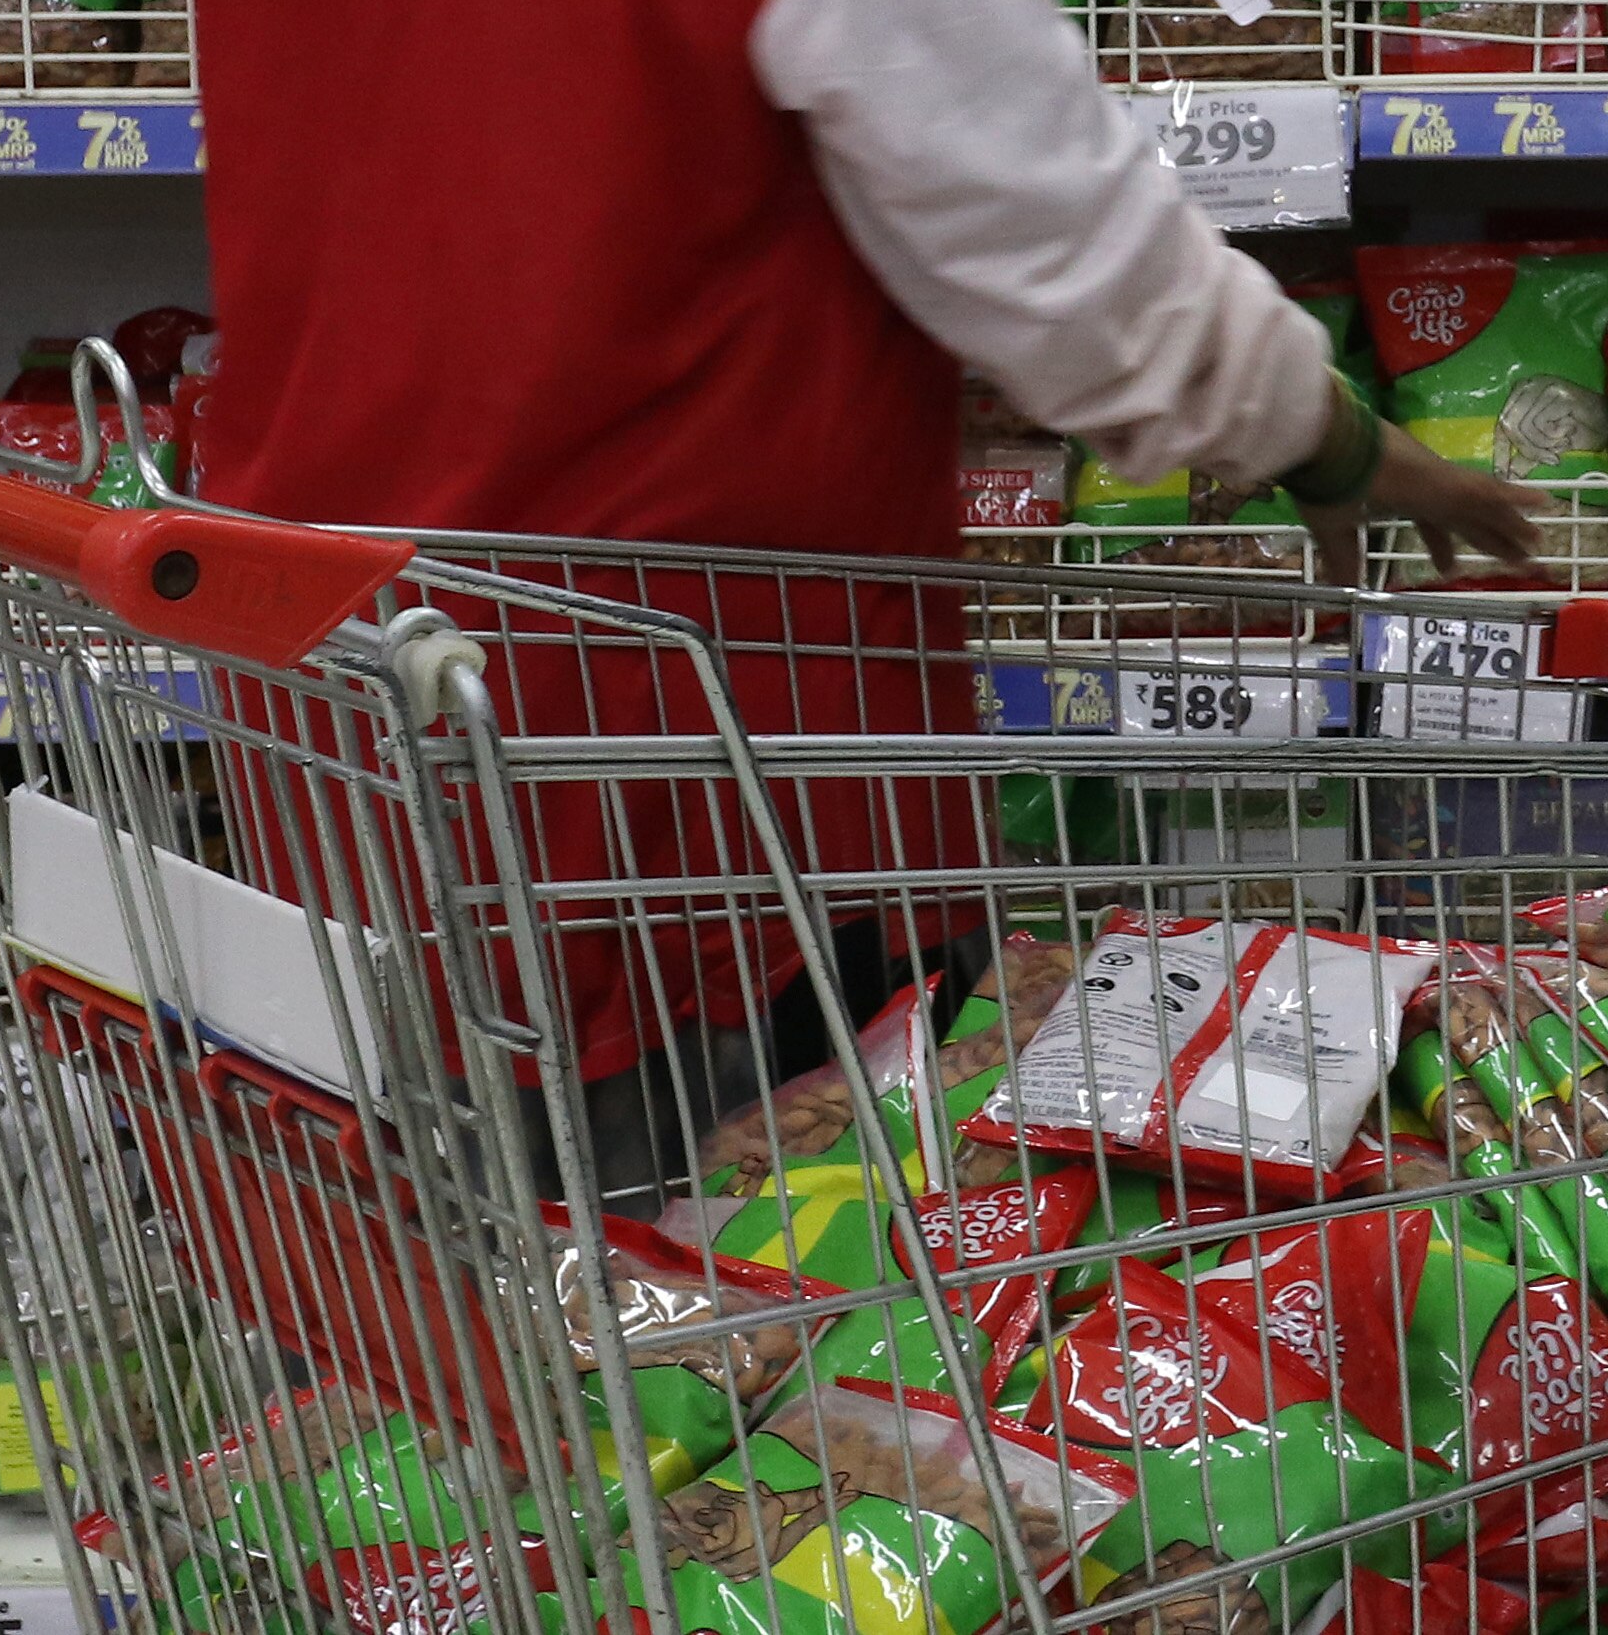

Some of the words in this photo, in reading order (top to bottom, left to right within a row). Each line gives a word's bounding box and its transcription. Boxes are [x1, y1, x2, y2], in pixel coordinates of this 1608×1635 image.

[1209, 98, 1257, 116] Price
[1388, 282, 1465, 320] Good
[1410, 306, 1466, 344] Life
[1425, 618, 1459, 637] Our
